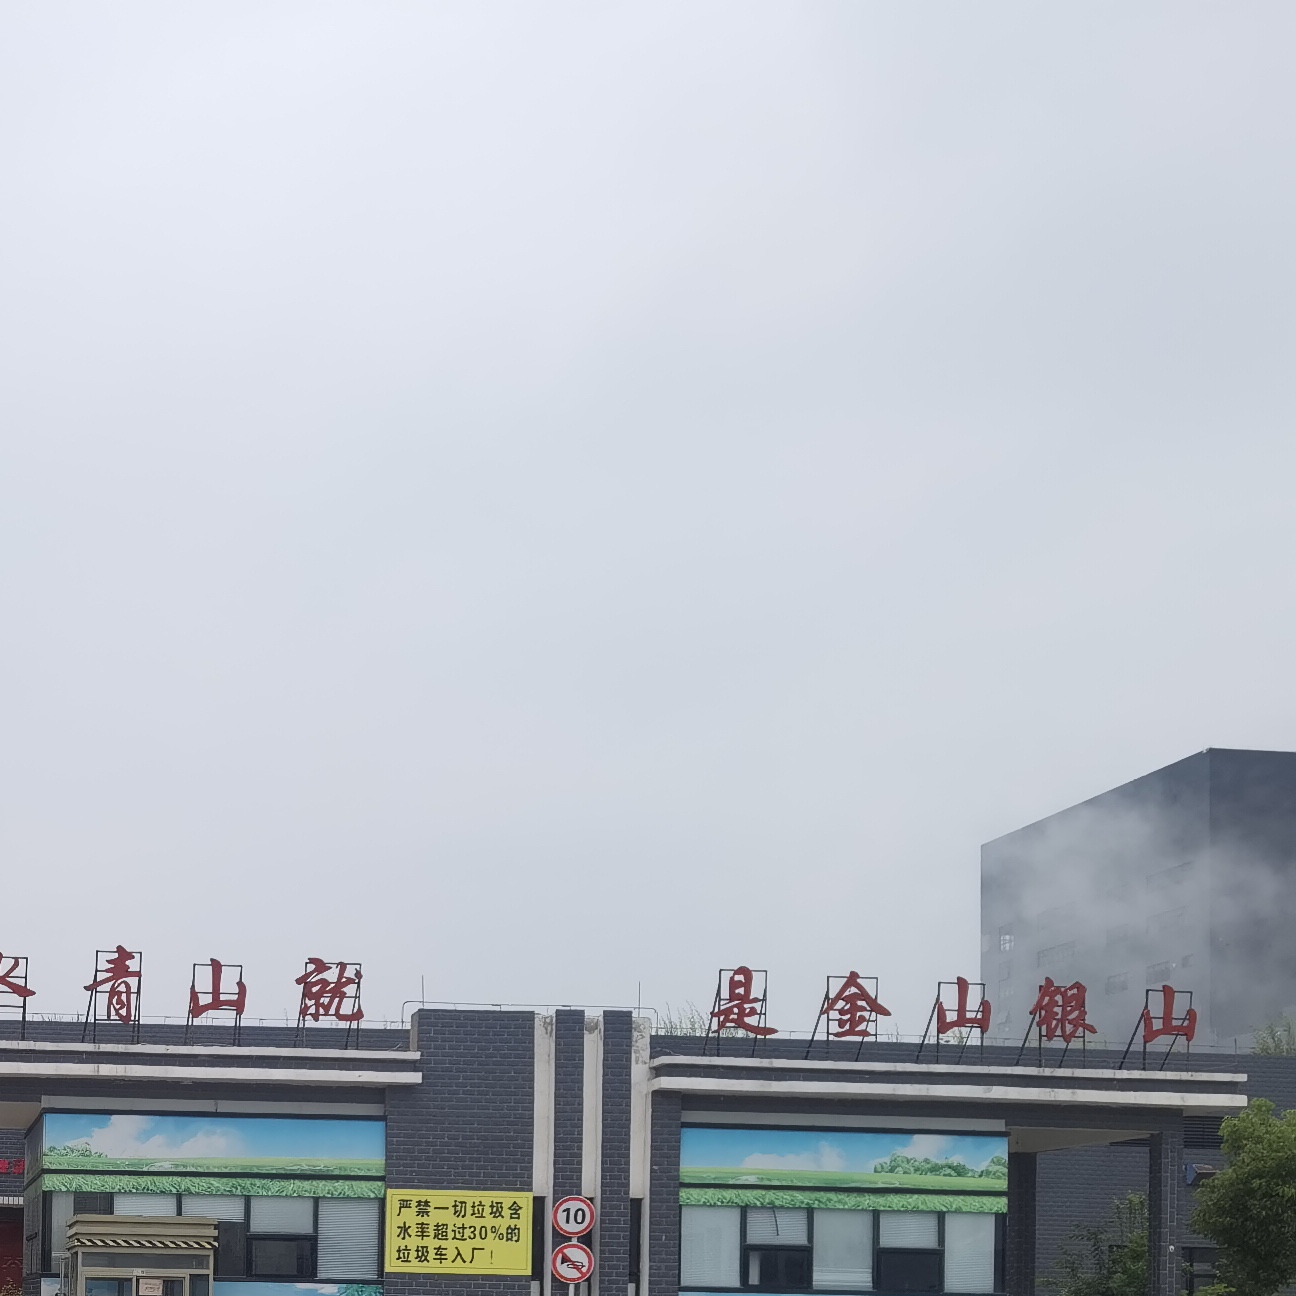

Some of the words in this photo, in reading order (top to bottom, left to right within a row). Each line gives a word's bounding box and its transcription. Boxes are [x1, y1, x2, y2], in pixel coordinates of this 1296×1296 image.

[710, 966, 1197, 1043] 是金山银山
[396, 1199, 523, 1220] 严禁一切垃圾含
[562, 1208, 586, 1225] 10
[396, 1221, 521, 1243] 水率超过30%的
